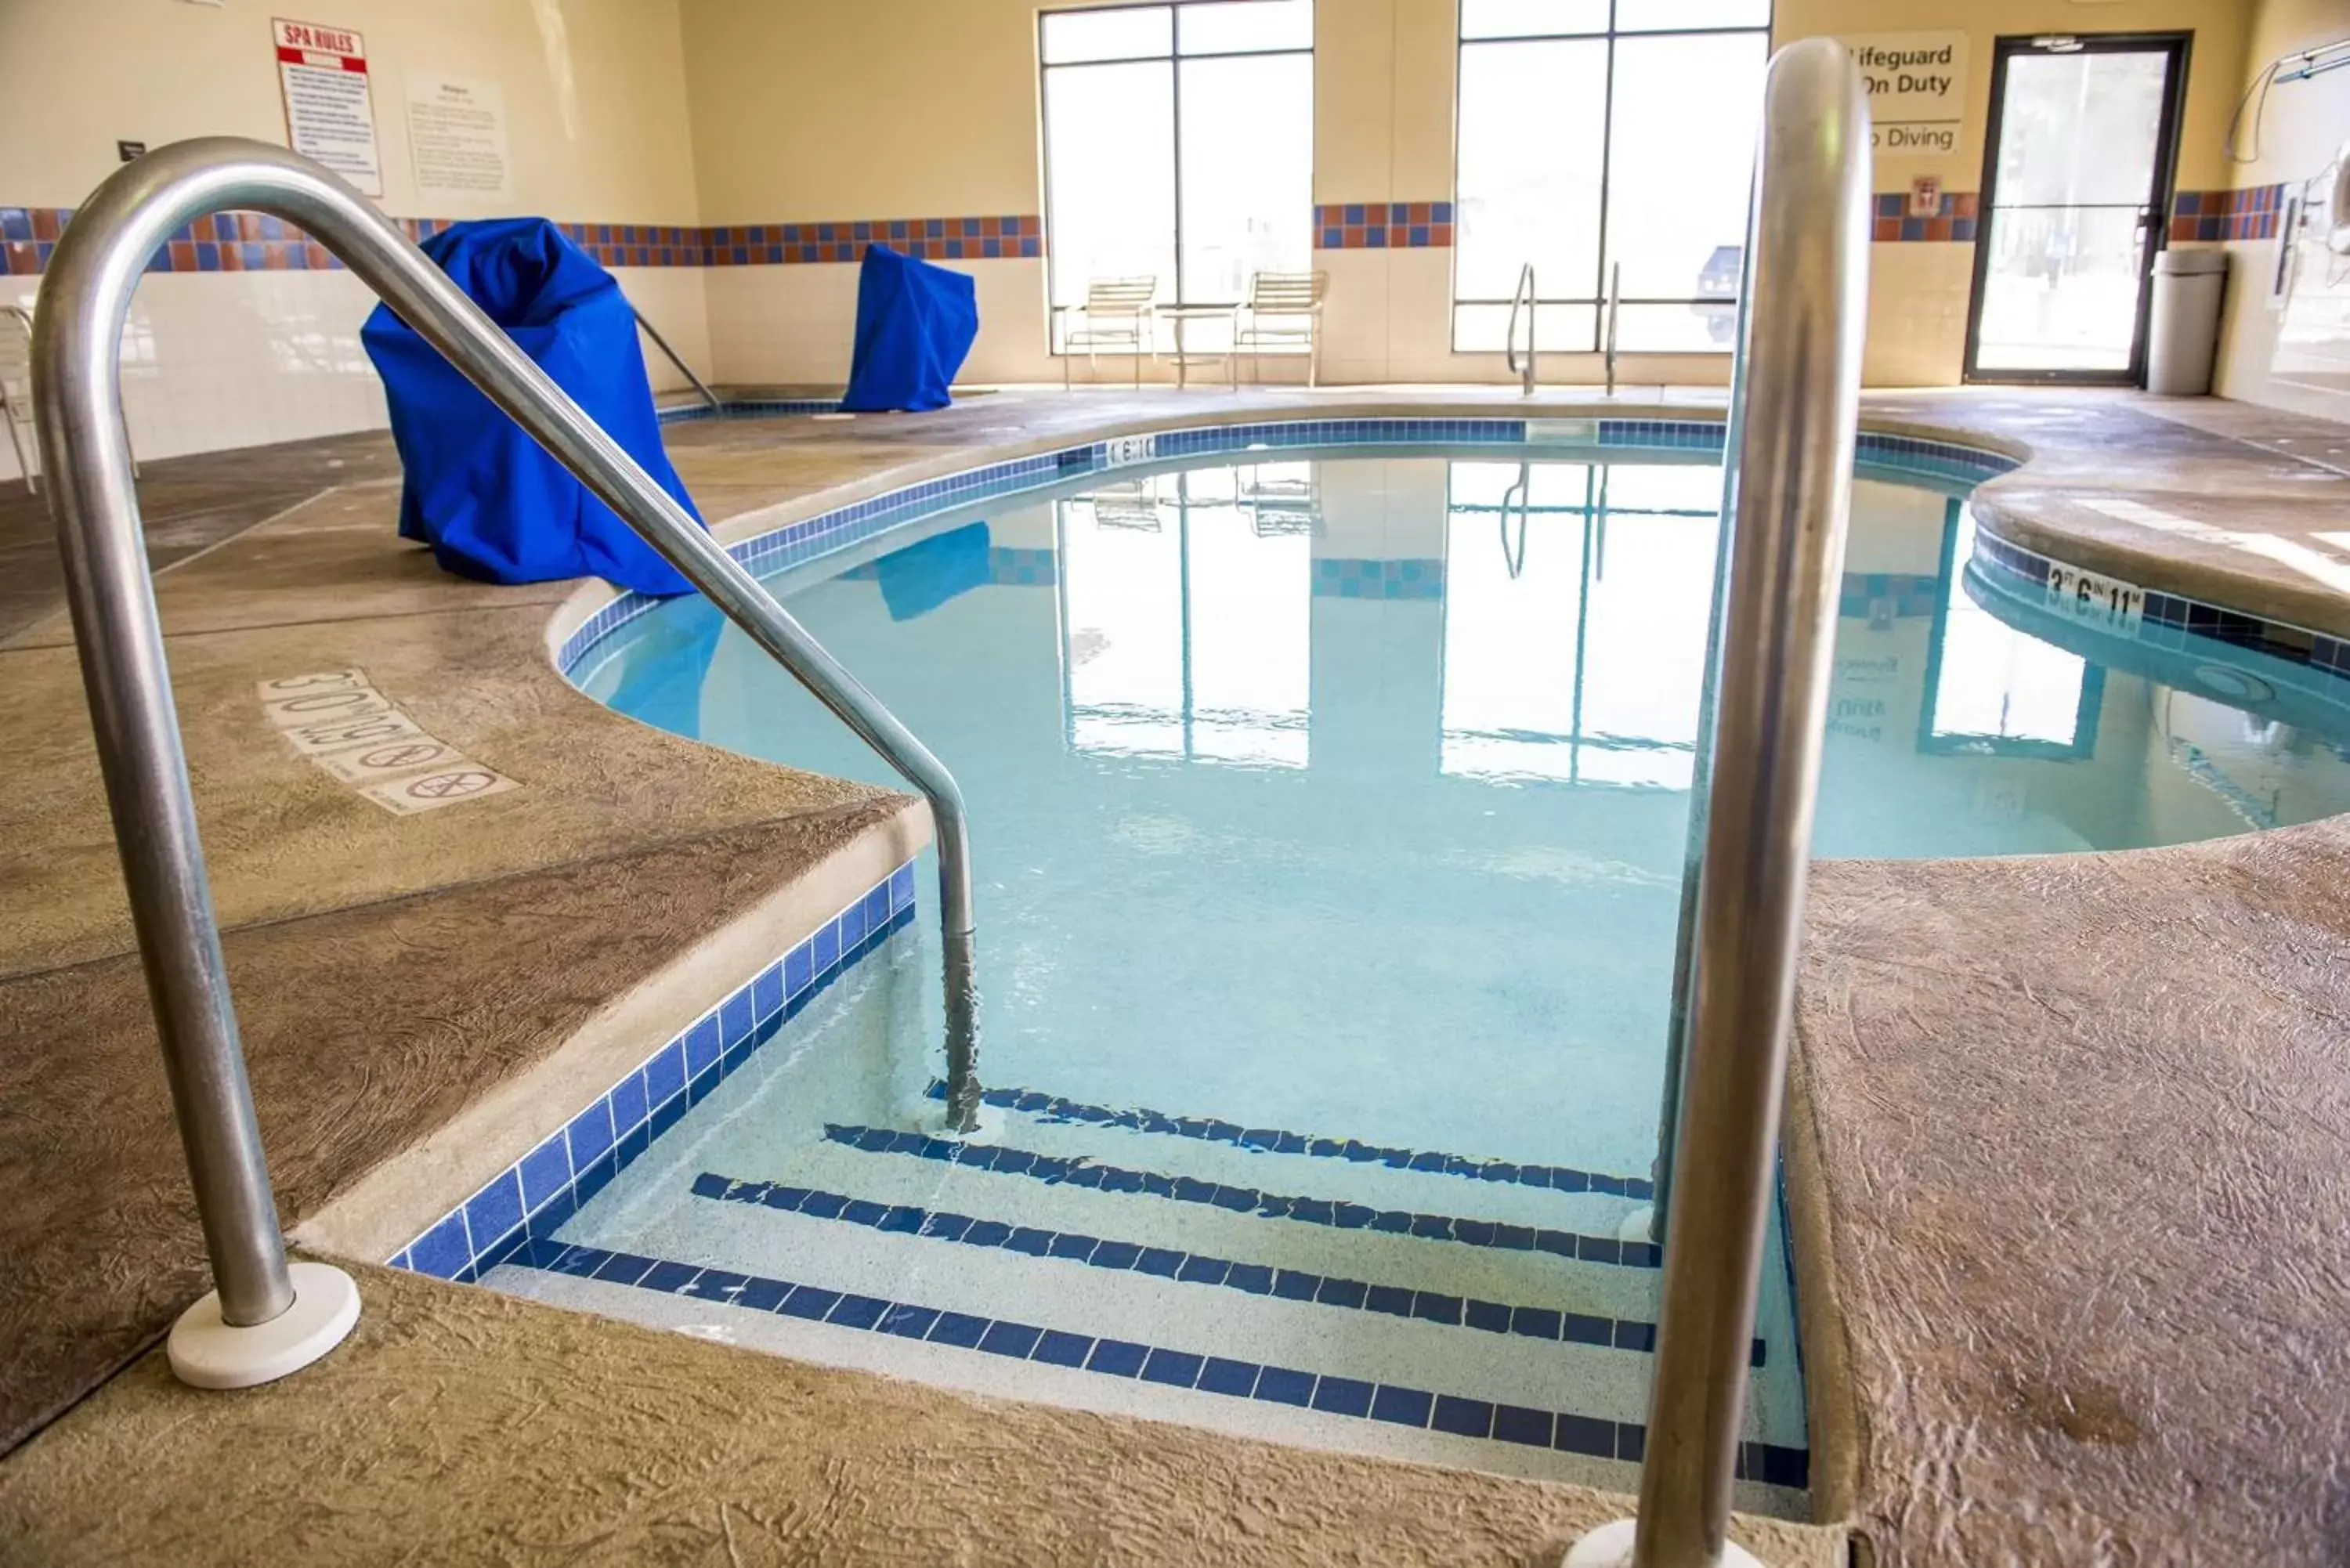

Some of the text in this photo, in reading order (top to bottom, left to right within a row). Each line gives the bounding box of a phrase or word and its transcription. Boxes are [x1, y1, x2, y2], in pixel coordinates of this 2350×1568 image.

[284, 23, 354, 52] SPA RULES
[1849, 44, 1953, 71] ifeguard
[1898, 74, 1952, 96] Duty
[1888, 126, 1954, 151] Diving
